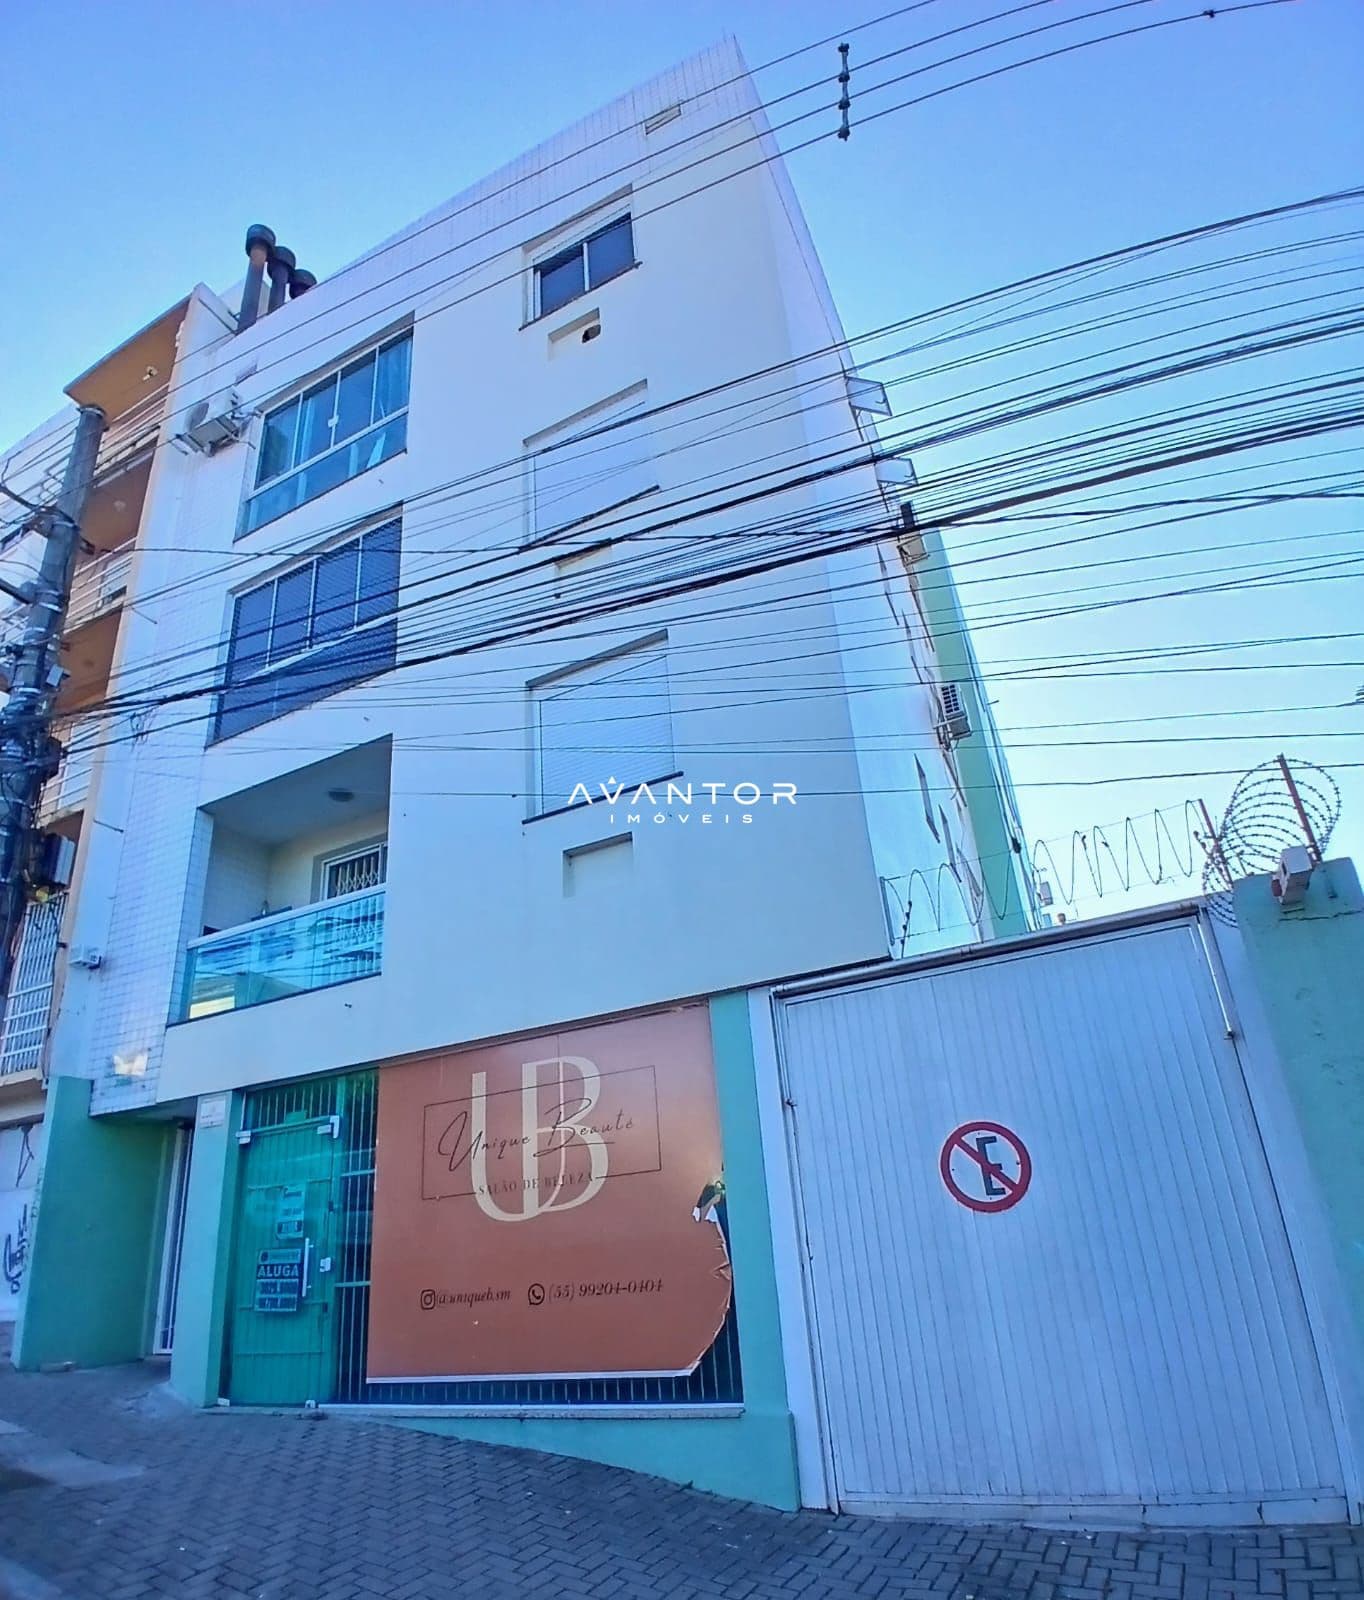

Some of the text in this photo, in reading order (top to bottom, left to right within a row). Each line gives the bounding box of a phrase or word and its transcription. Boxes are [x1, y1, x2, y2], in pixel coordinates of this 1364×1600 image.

[438, 1111, 531, 1172] Unique
[522, 1177, 541, 1190] DE
[257, 1264, 299, 1278] ALUGA
[549, 1283, 575, 1302] (55)
